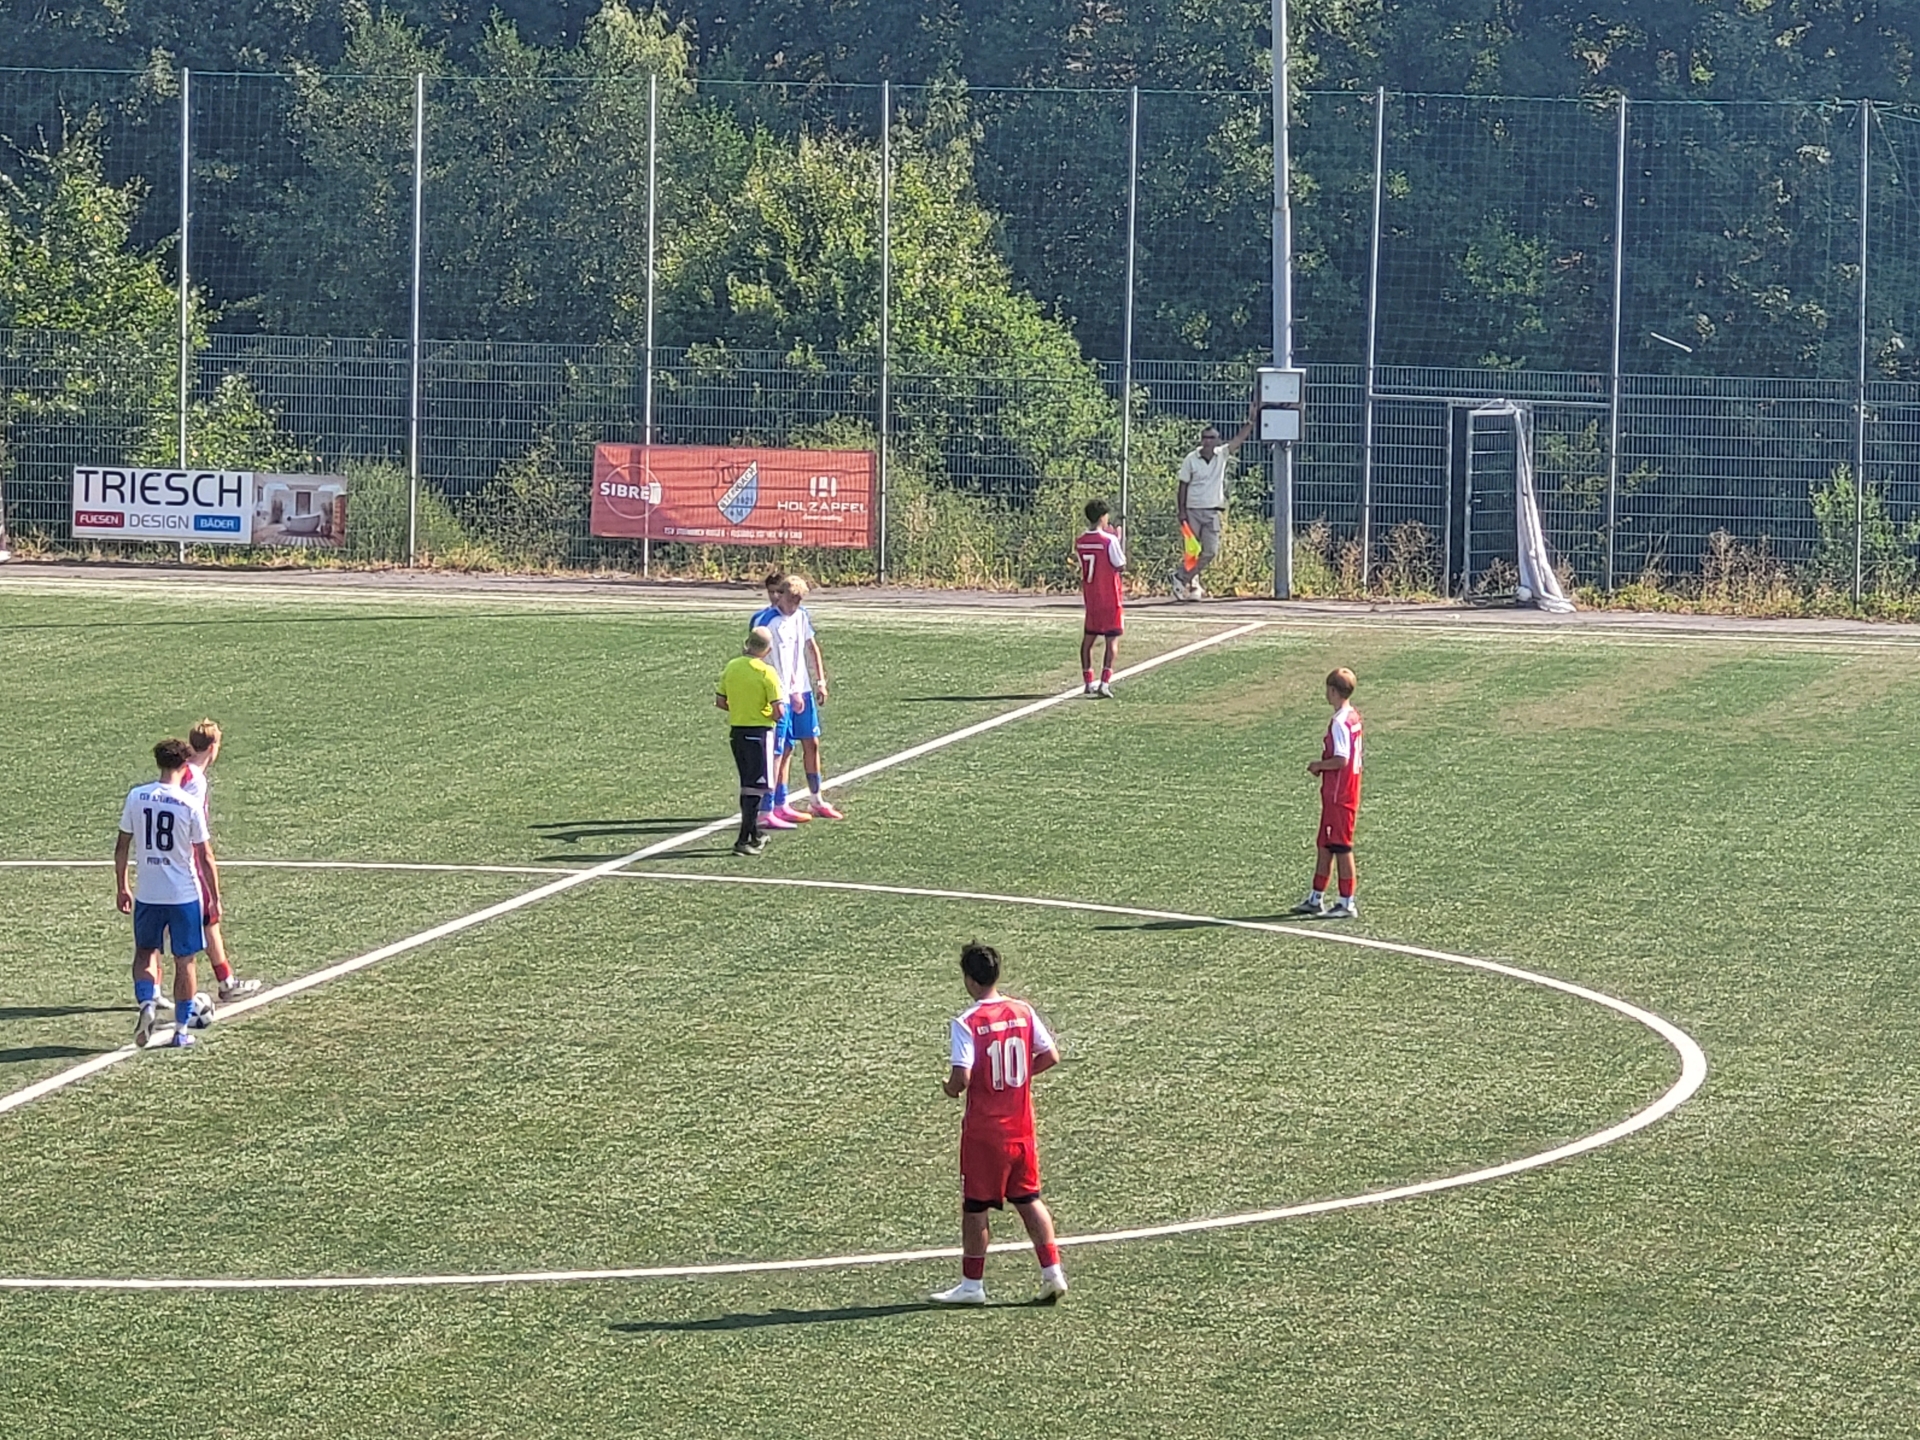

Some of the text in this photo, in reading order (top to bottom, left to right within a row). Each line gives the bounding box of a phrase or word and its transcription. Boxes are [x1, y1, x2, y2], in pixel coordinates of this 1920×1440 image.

[76, 470, 242, 507] TRIESCH
[600, 482, 650, 500] SIBRE
[777, 500, 868, 513] HOLZAPFEL
[129, 513, 189, 530] DESIGN
[1082, 554, 1095, 583] 7
[143, 807, 174, 852] 18
[986, 1036, 1027, 1091] 10
